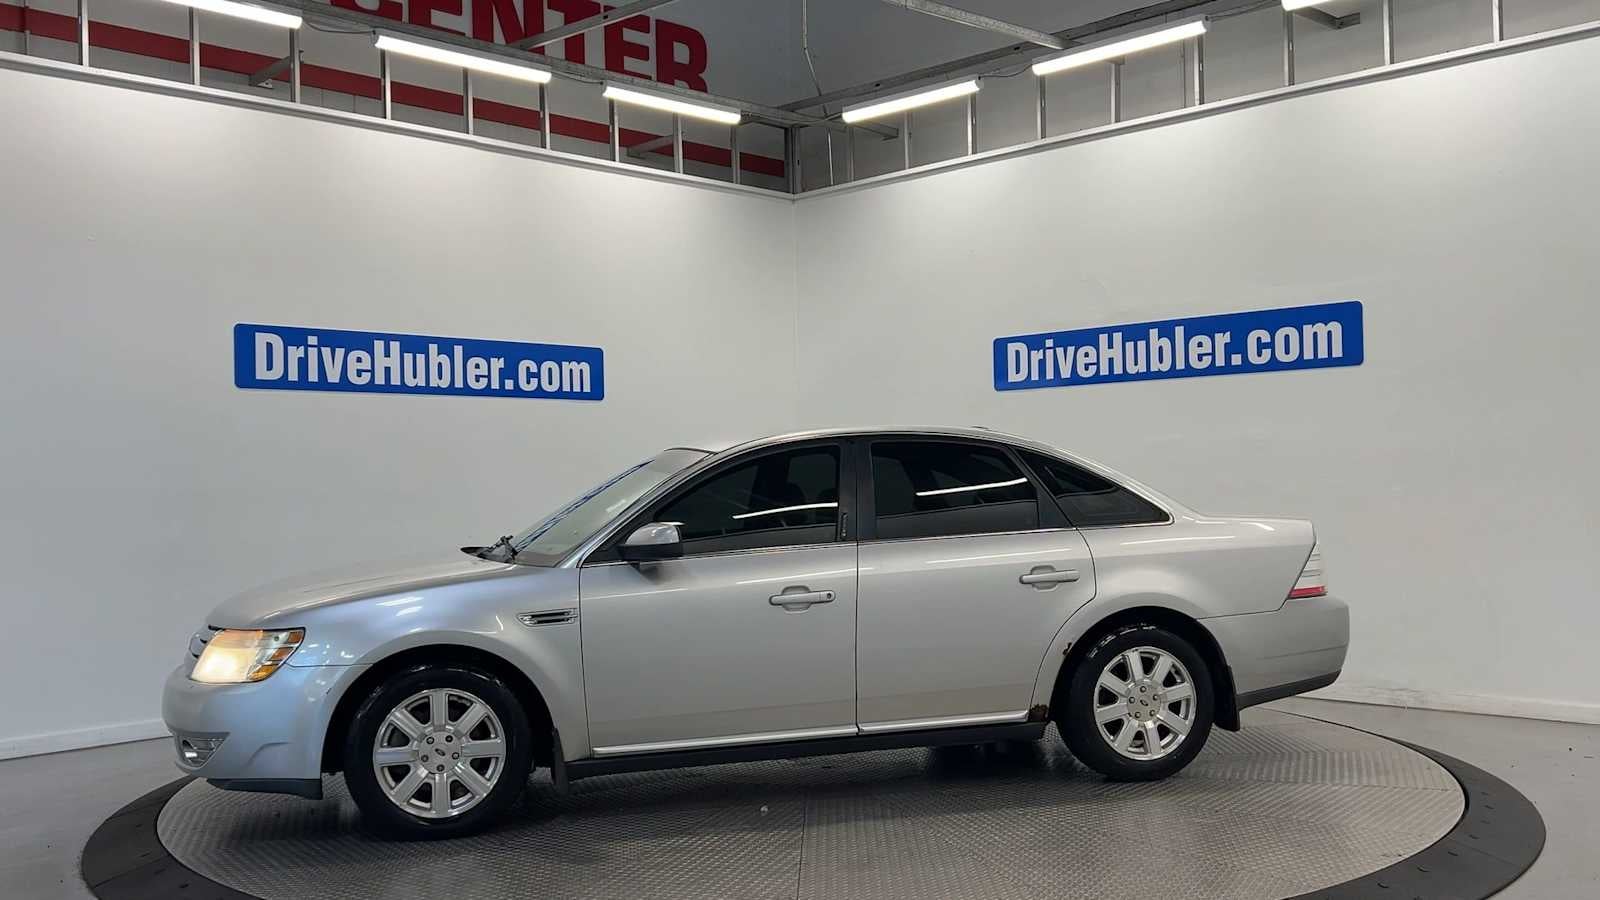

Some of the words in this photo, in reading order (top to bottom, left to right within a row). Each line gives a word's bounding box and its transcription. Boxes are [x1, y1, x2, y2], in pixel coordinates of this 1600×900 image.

[331, 0, 709, 93] ENTER
[254, 331, 591, 393] DriveHubler.com
[1006, 320, 1344, 384] DriveHubler.com
